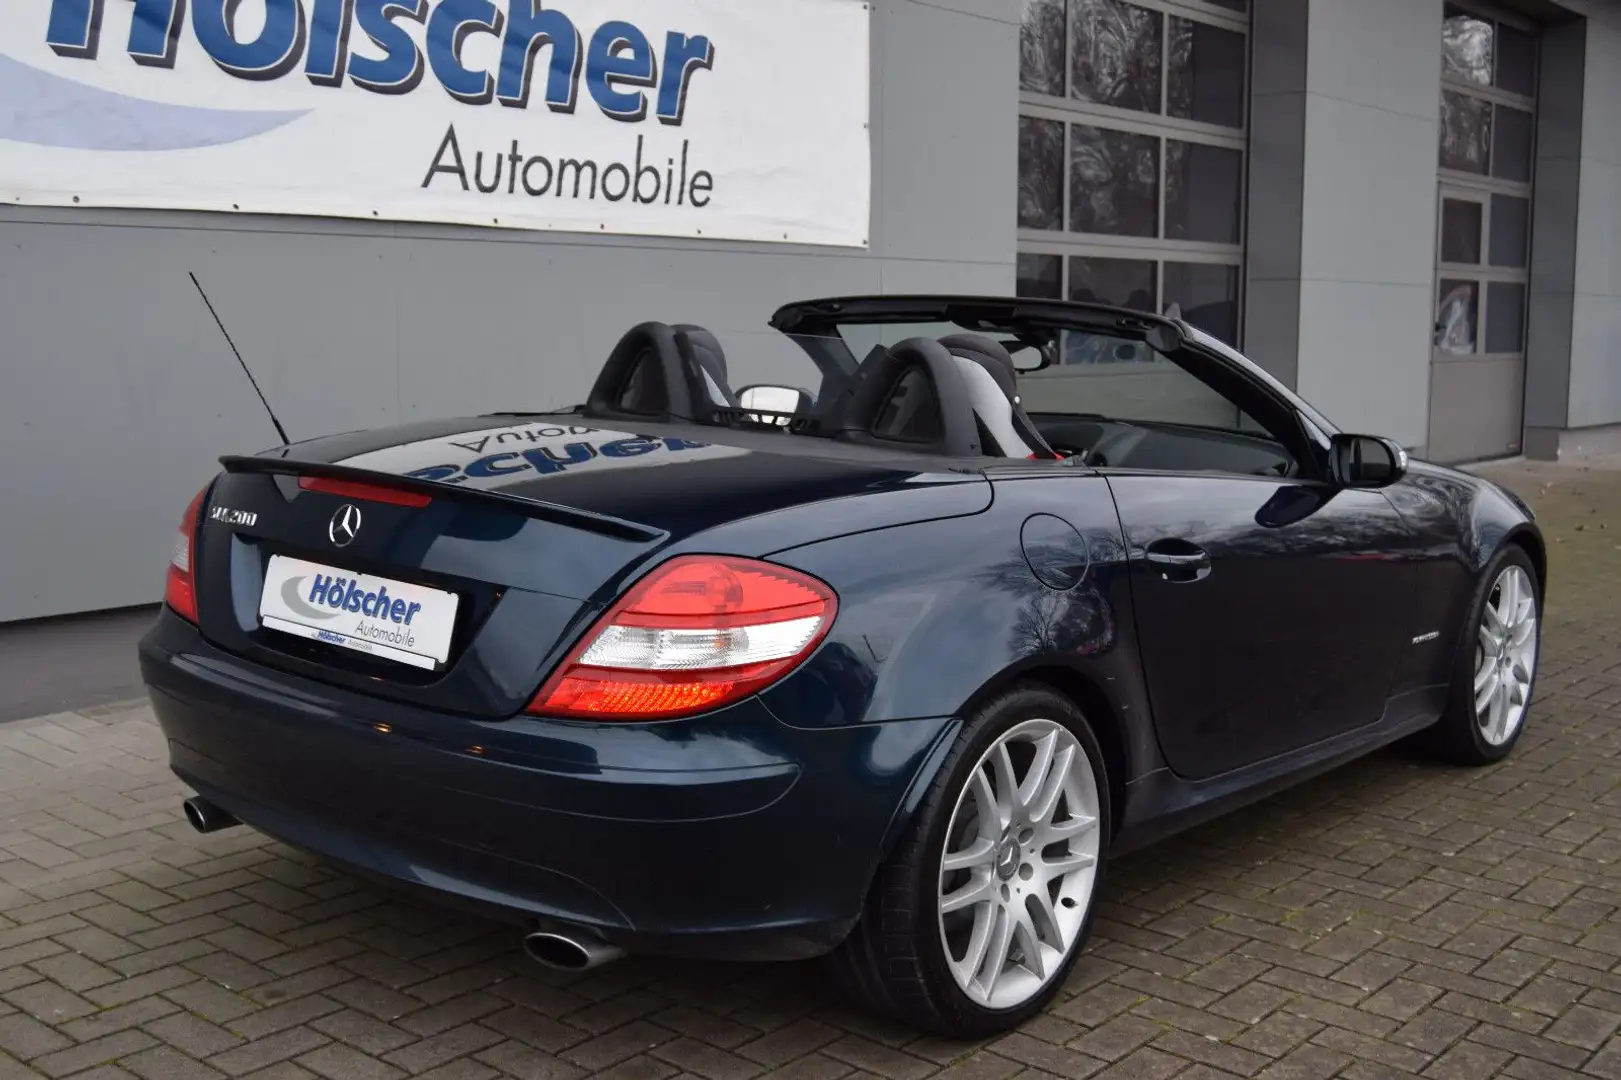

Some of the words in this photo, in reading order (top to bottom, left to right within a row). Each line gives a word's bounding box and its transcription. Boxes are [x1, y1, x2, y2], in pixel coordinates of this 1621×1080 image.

[421, 123, 713, 207] Automobile
[308, 573, 421, 625] Hölscher
[355, 620, 415, 647] Automobile
